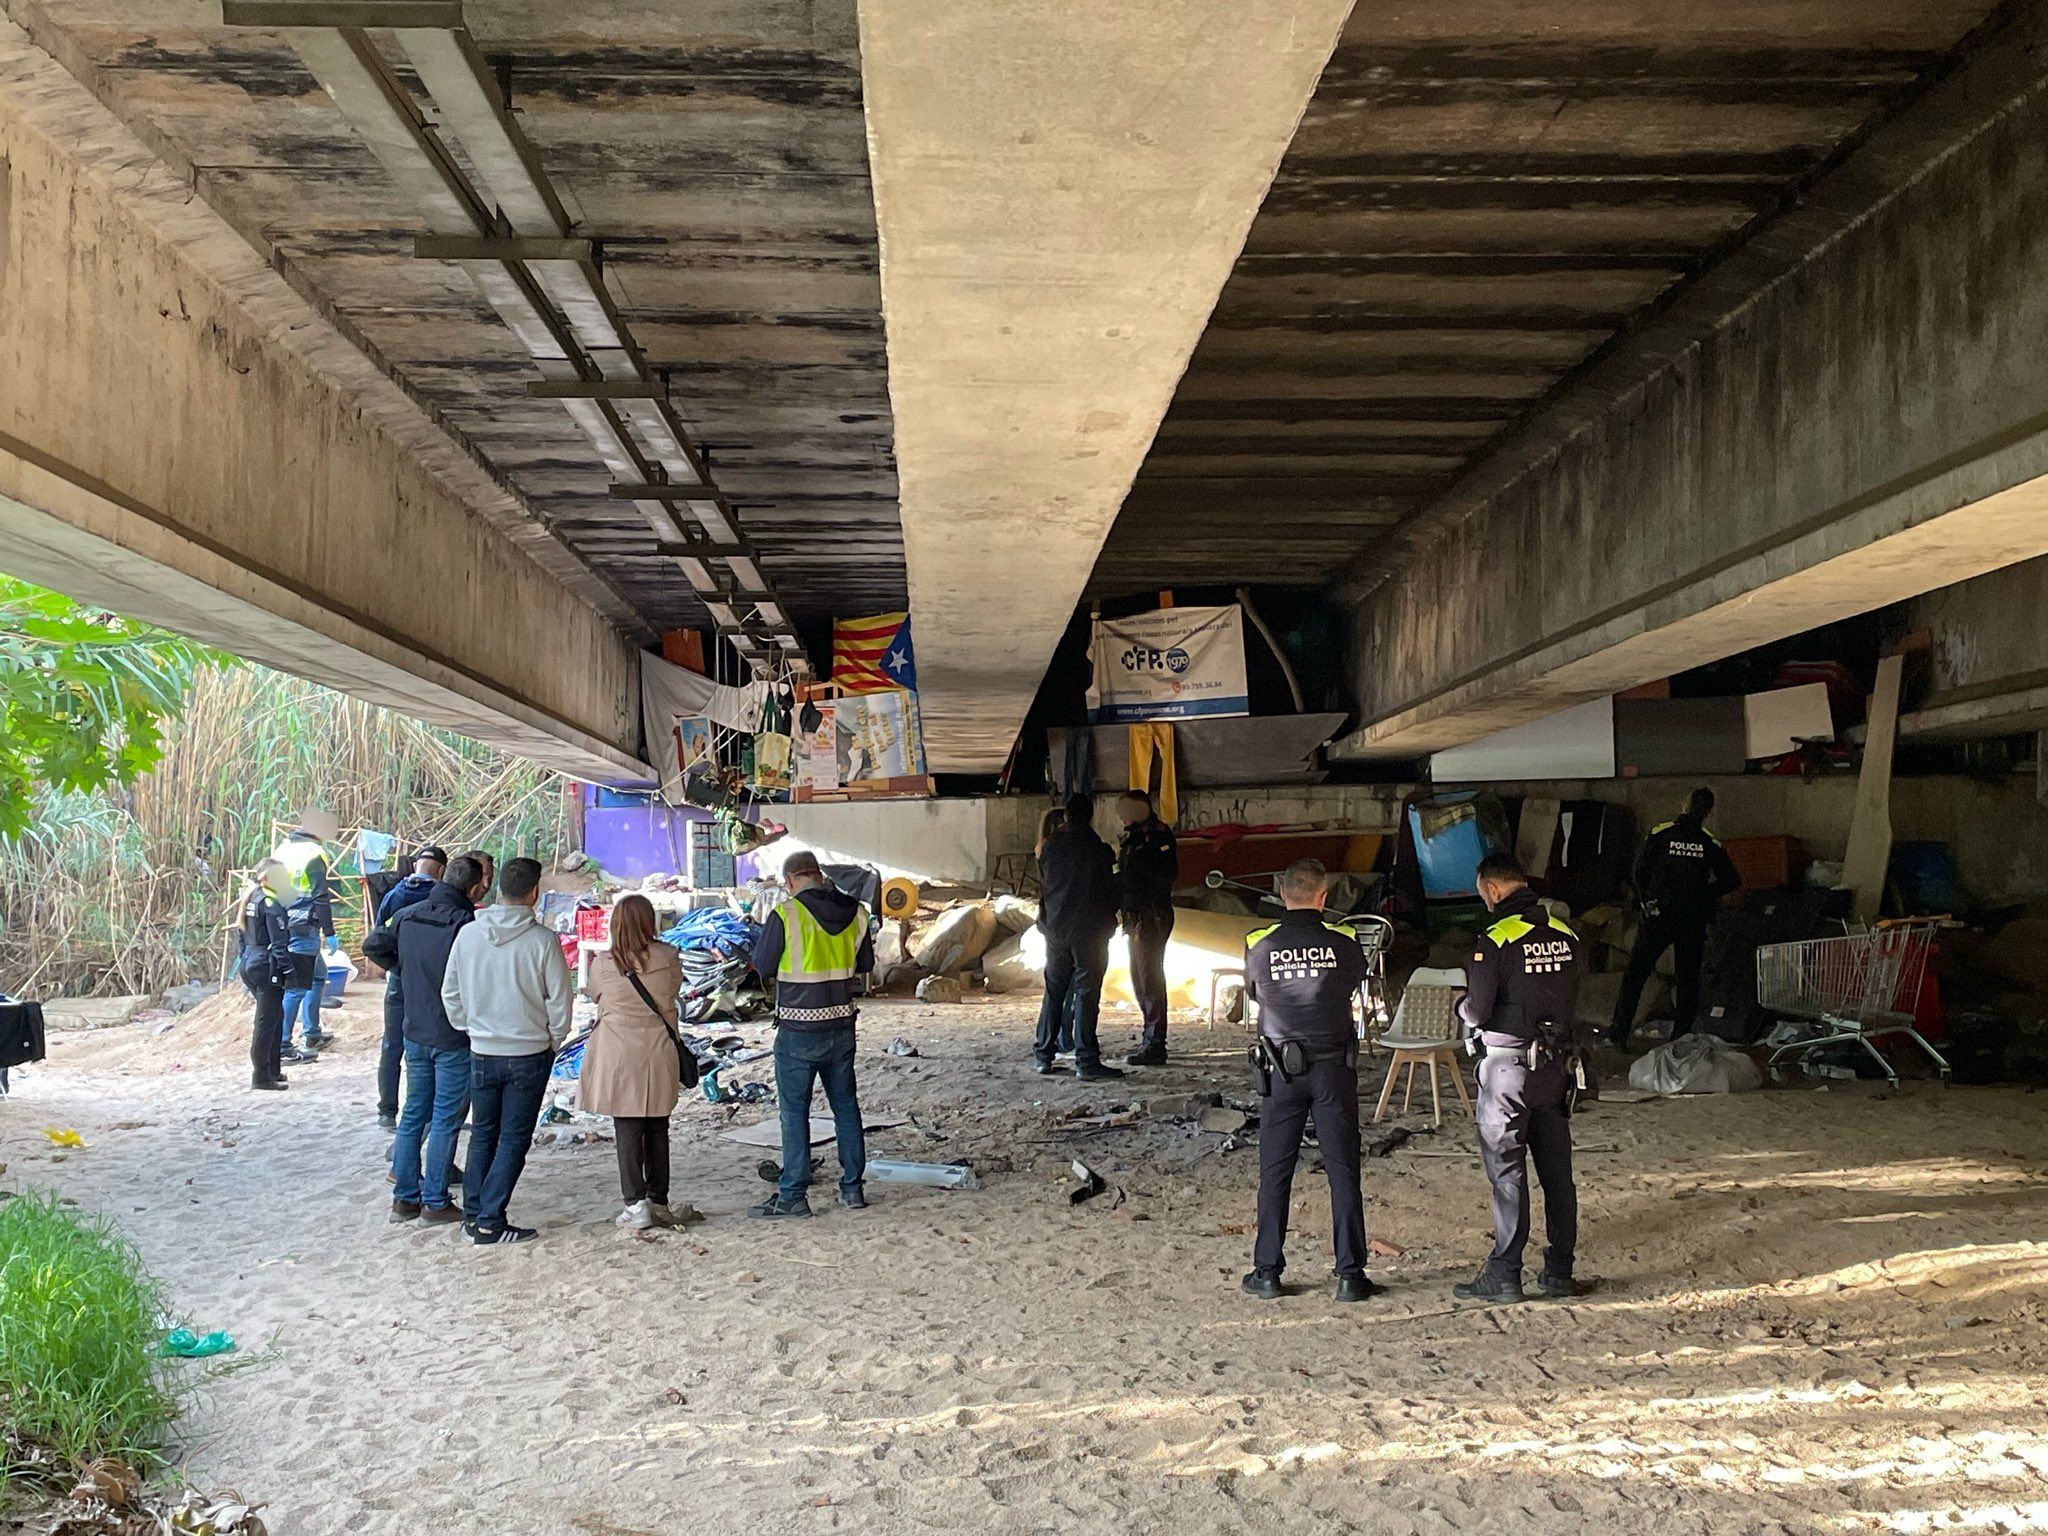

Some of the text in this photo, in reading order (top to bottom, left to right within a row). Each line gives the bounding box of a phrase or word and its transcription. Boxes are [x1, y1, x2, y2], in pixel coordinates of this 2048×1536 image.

[1167, 656, 1188, 670] 1979
[1669, 841, 1703, 851] POLICIA
[1523, 941, 1571, 956] POLICIA
[1270, 948, 1335, 964] POLICIA
